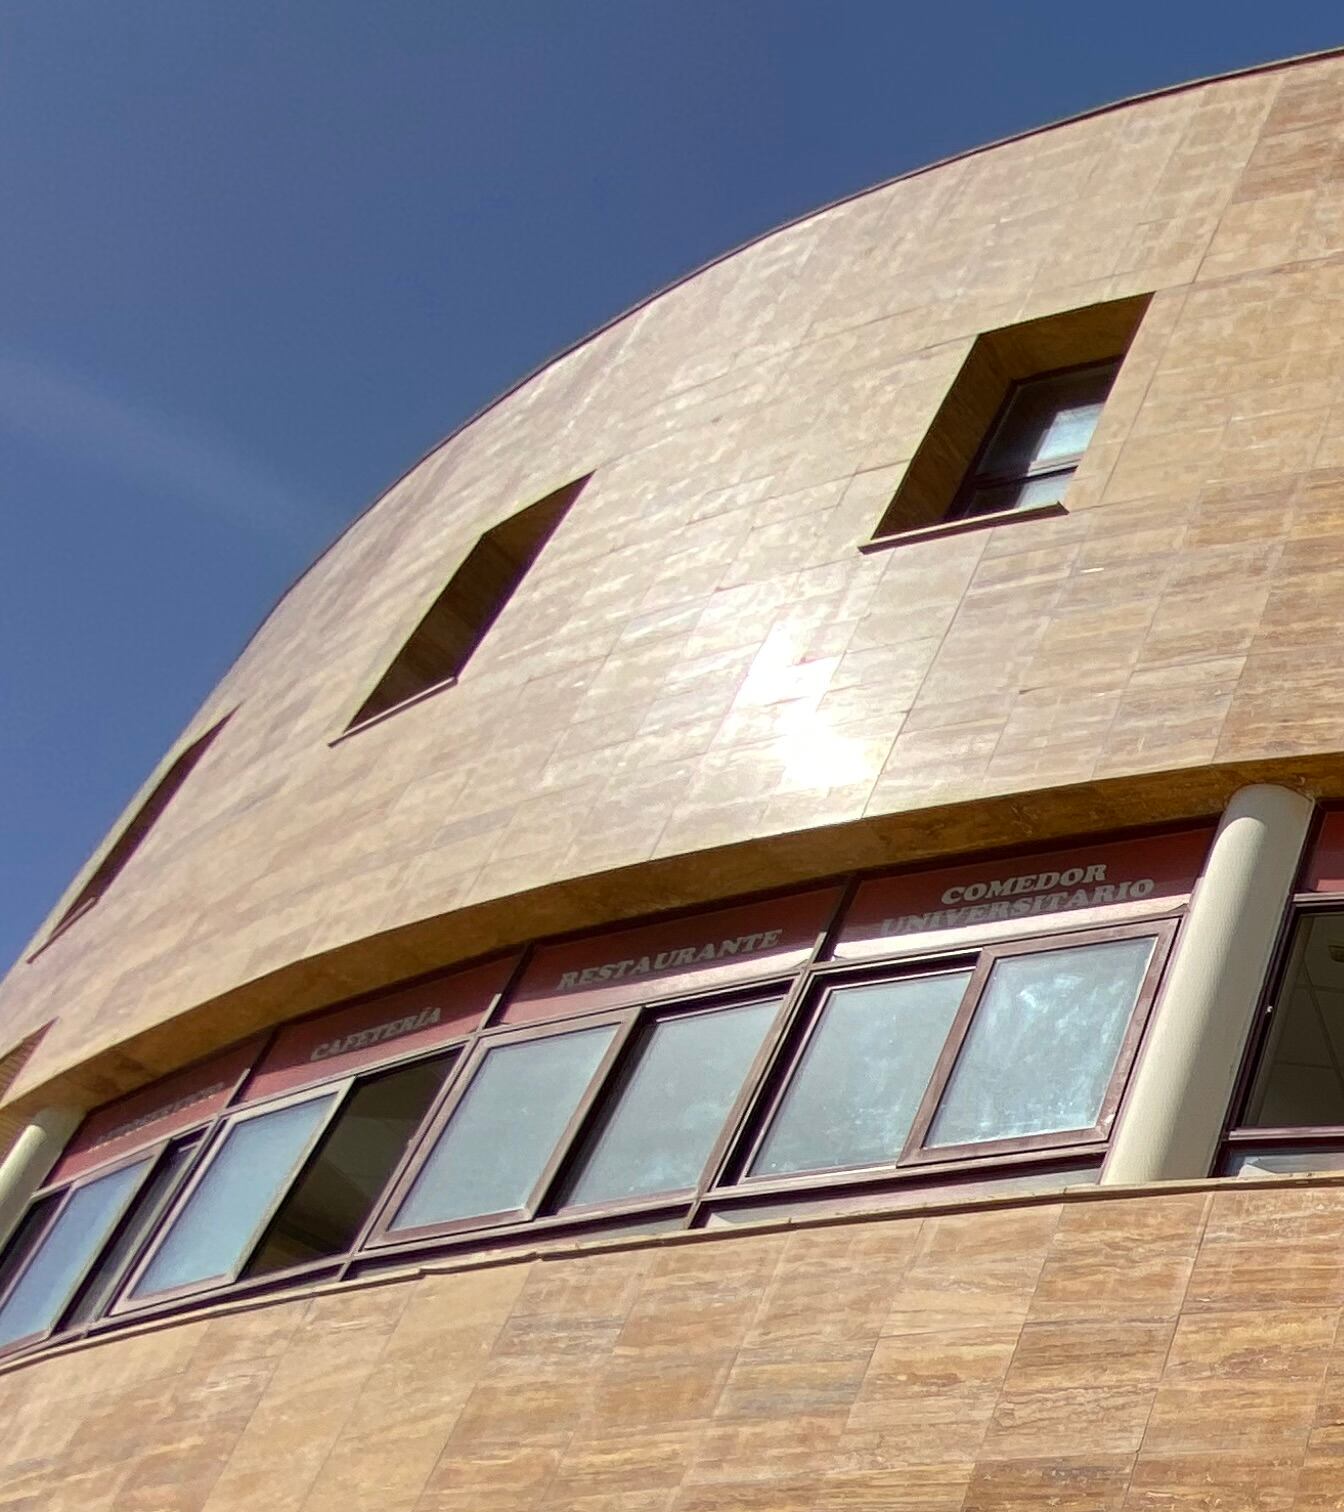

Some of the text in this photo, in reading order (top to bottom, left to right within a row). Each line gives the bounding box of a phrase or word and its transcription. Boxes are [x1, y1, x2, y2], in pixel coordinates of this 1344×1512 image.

[879, 879, 1155, 938] UNIVERSITARIO
[940, 864, 1107, 905] COMEDOR
[556, 929, 783, 991] RESTAURANTE
